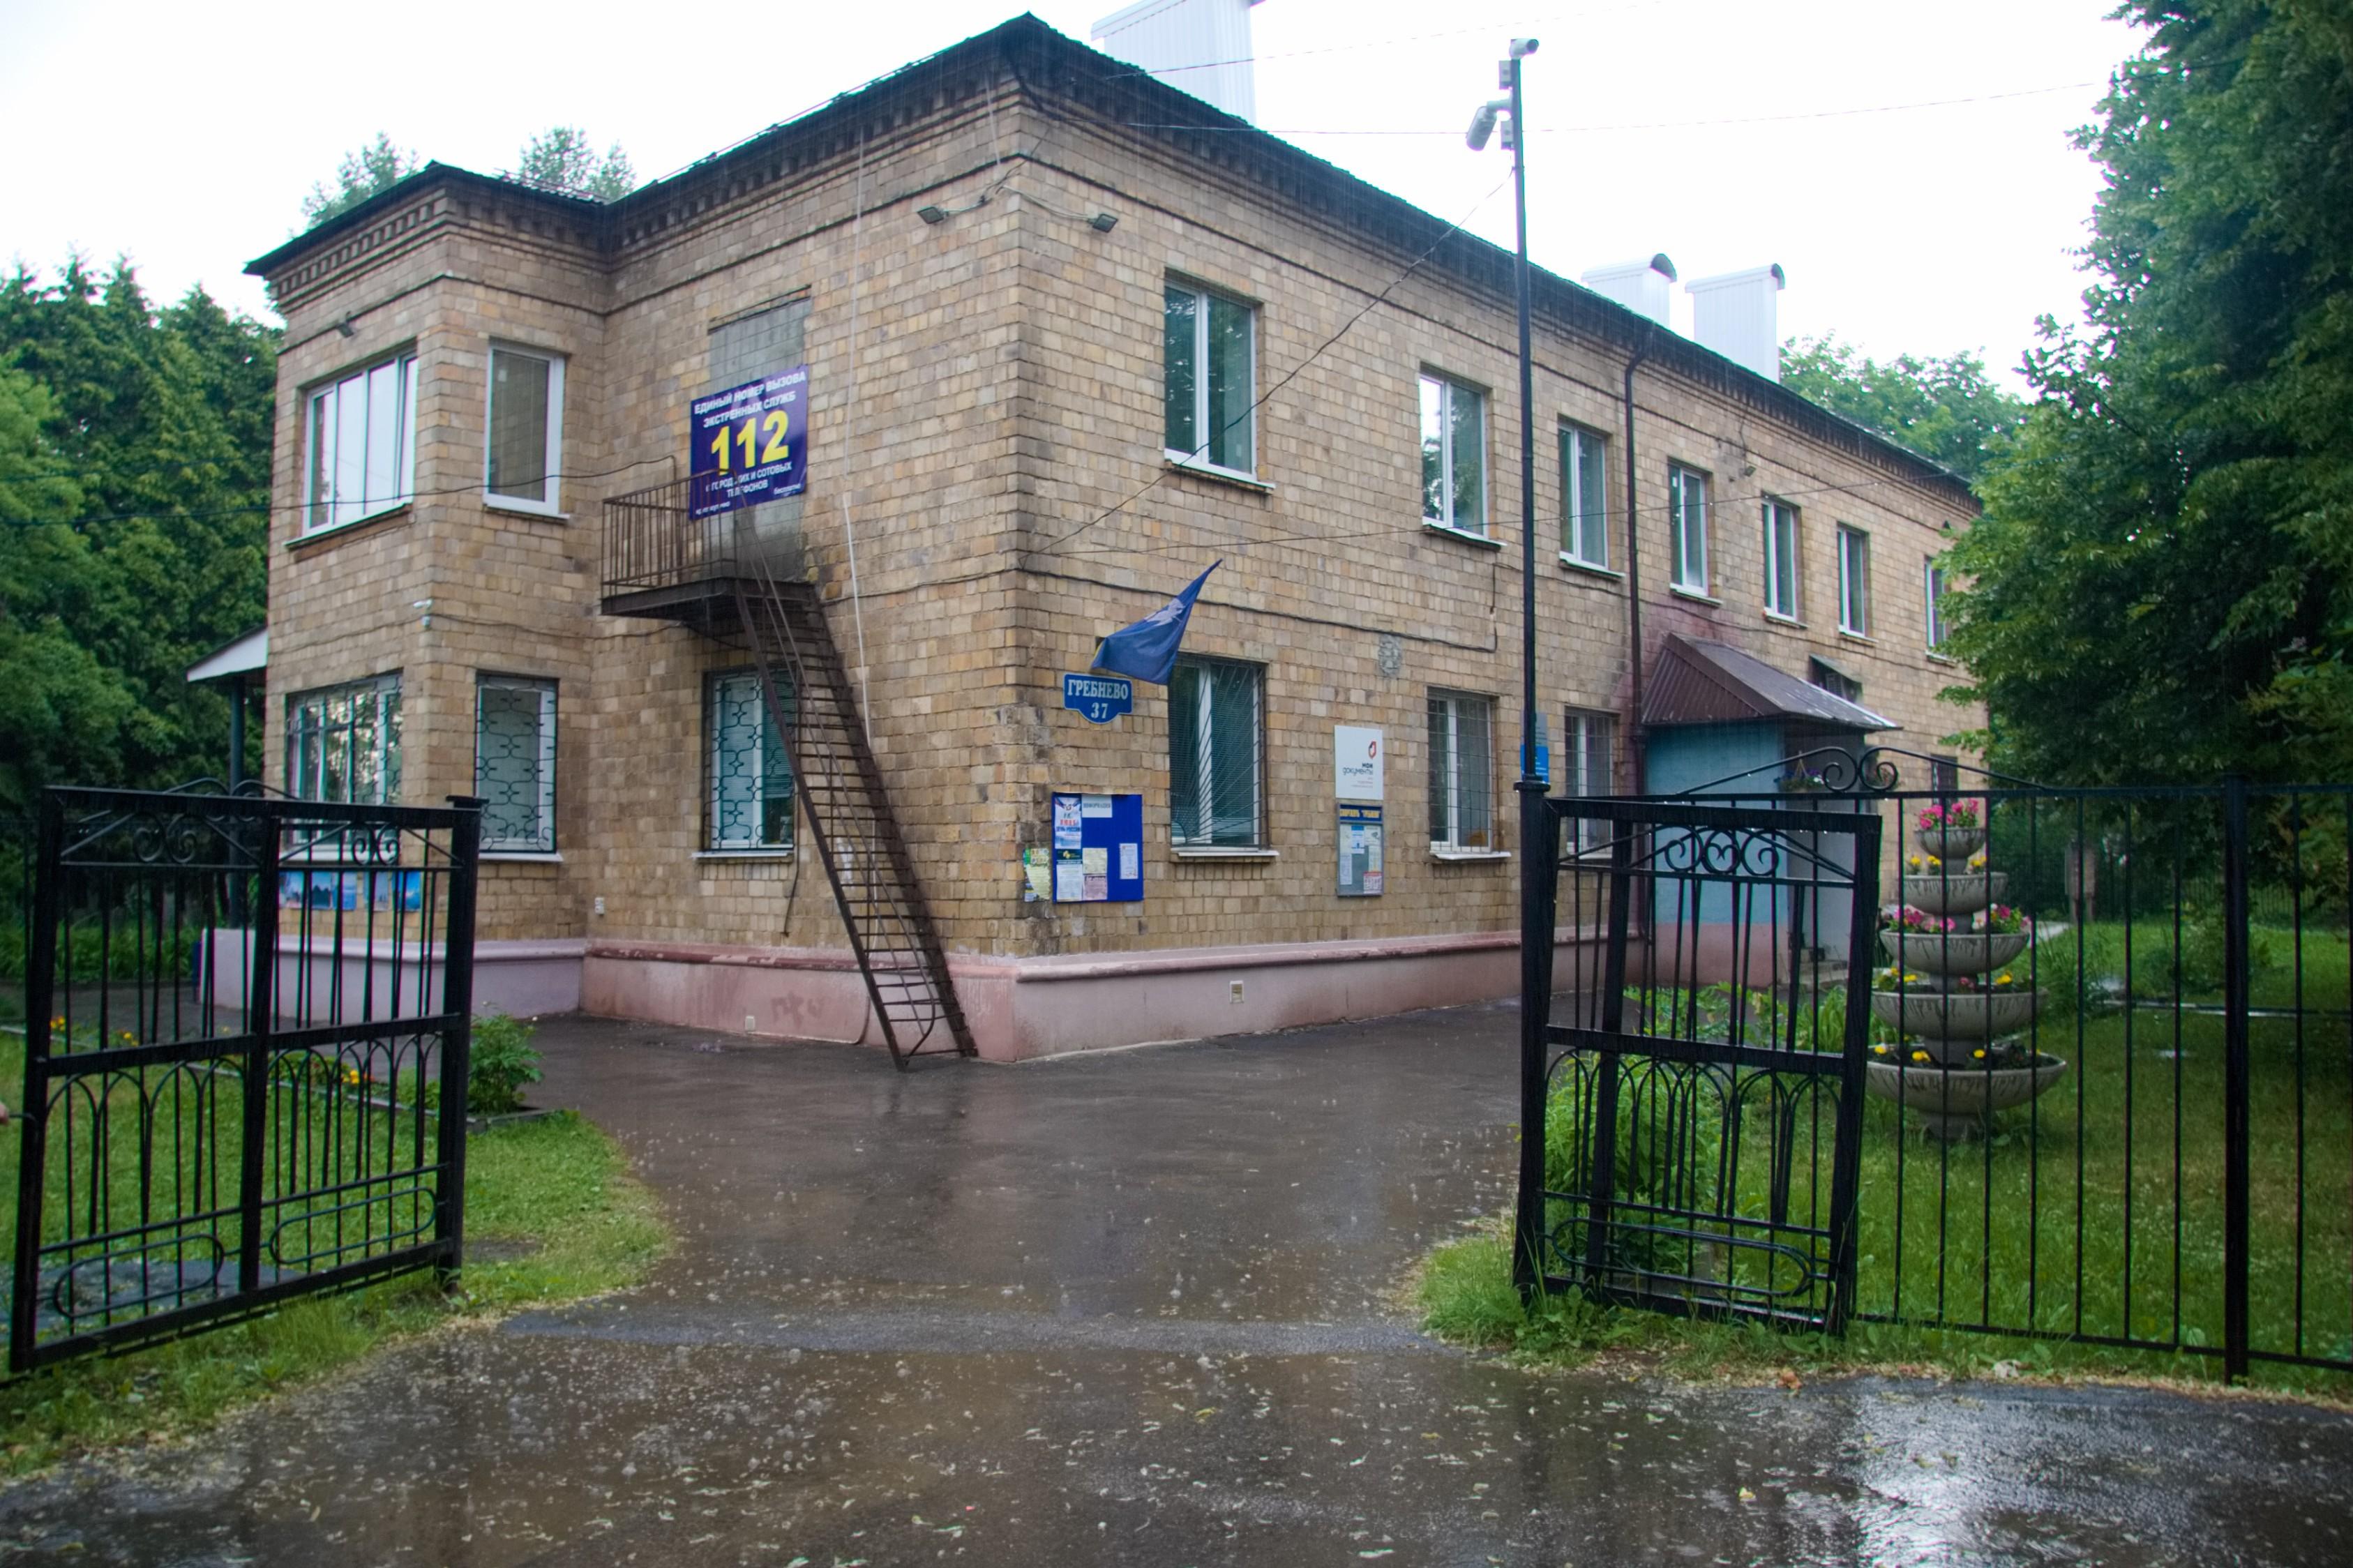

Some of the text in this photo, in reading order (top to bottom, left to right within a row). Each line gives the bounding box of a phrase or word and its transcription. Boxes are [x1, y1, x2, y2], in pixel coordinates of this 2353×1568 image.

[694, 371, 806, 414] ЕДИНЫЙ НОМЕР ВЫЗОВА
[703, 391, 797, 428] ЭКСТРЕННЫХ СЛУЖБ
[712, 409, 789, 476] 112
[712, 474, 749, 492] ГОРОДИХ
[757, 461, 792, 478] СОТОВЫХ
[727, 479, 769, 498] ТЕЛФОНОВ
[1067, 679, 1129, 700] ГРЕБНЕВО
[1090, 702, 1108, 719] 37
